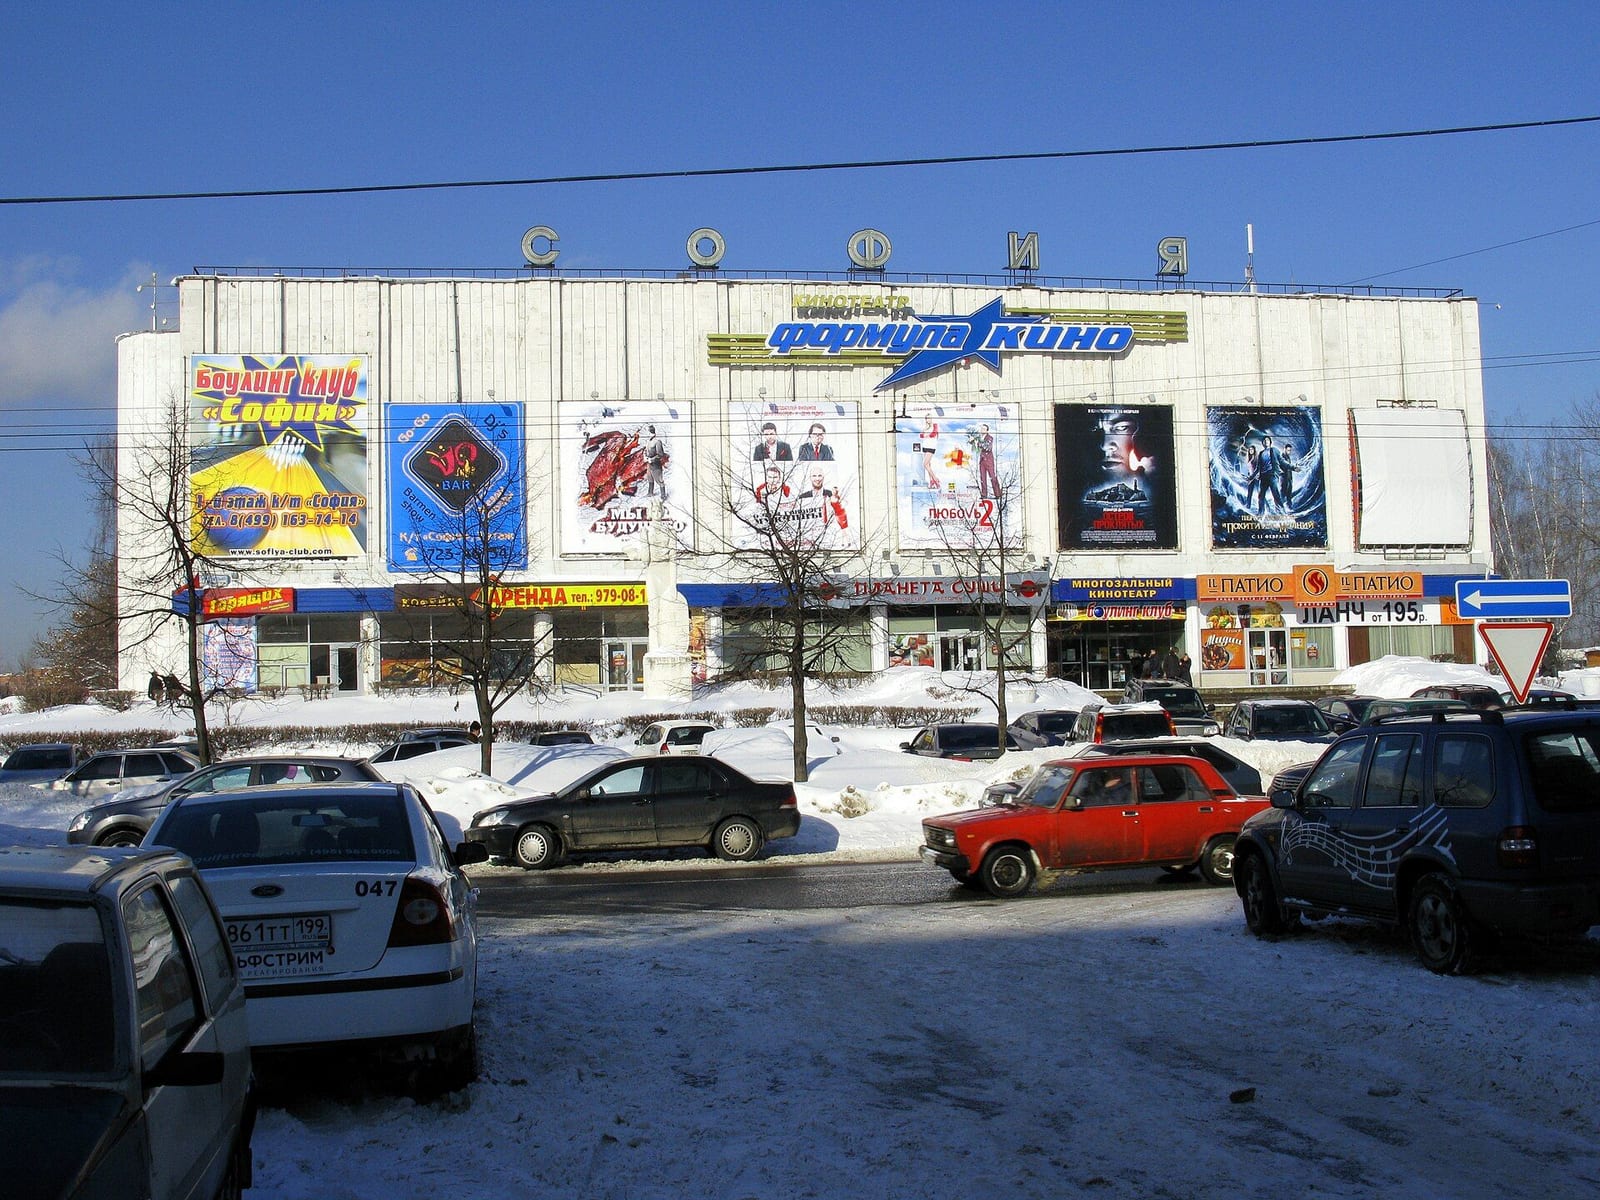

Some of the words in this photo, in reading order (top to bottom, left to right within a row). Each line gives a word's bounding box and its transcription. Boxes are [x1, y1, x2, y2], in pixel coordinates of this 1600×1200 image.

[791, 294, 910, 309] КИНОТЕАТР
[442, 479, 471, 491] BAR
[226, 493, 268, 510] этаж
[402, 487, 437, 521] Barmen
[401, 500, 425, 523] show
[979, 499, 995, 526] 2
[230, 513, 278, 531] 8(499)
[282, 512, 359, 528] 163-74-14
[1072, 577, 1173, 589] МНОГОЗАЛЬНЫЙ
[1221, 577, 1284, 593] ПАТИО
[1353, 576, 1414, 591] ПАТИО
[488, 587, 567, 606] АРЕНДА
[571, 592, 593, 604] тел.:
[595, 588, 646, 604] 979-08-1
[1089, 589, 1158, 599] КИНОТЕАТР
[1141, 600, 1173, 619] клуб
[1302, 601, 1366, 624] ЛАНЧ
[354, 880, 398, 898] 047
[227, 922, 290, 943] 861ТТ
[295, 918, 324, 934] 199
[236, 951, 324, 969] ЬФСТРИМ
